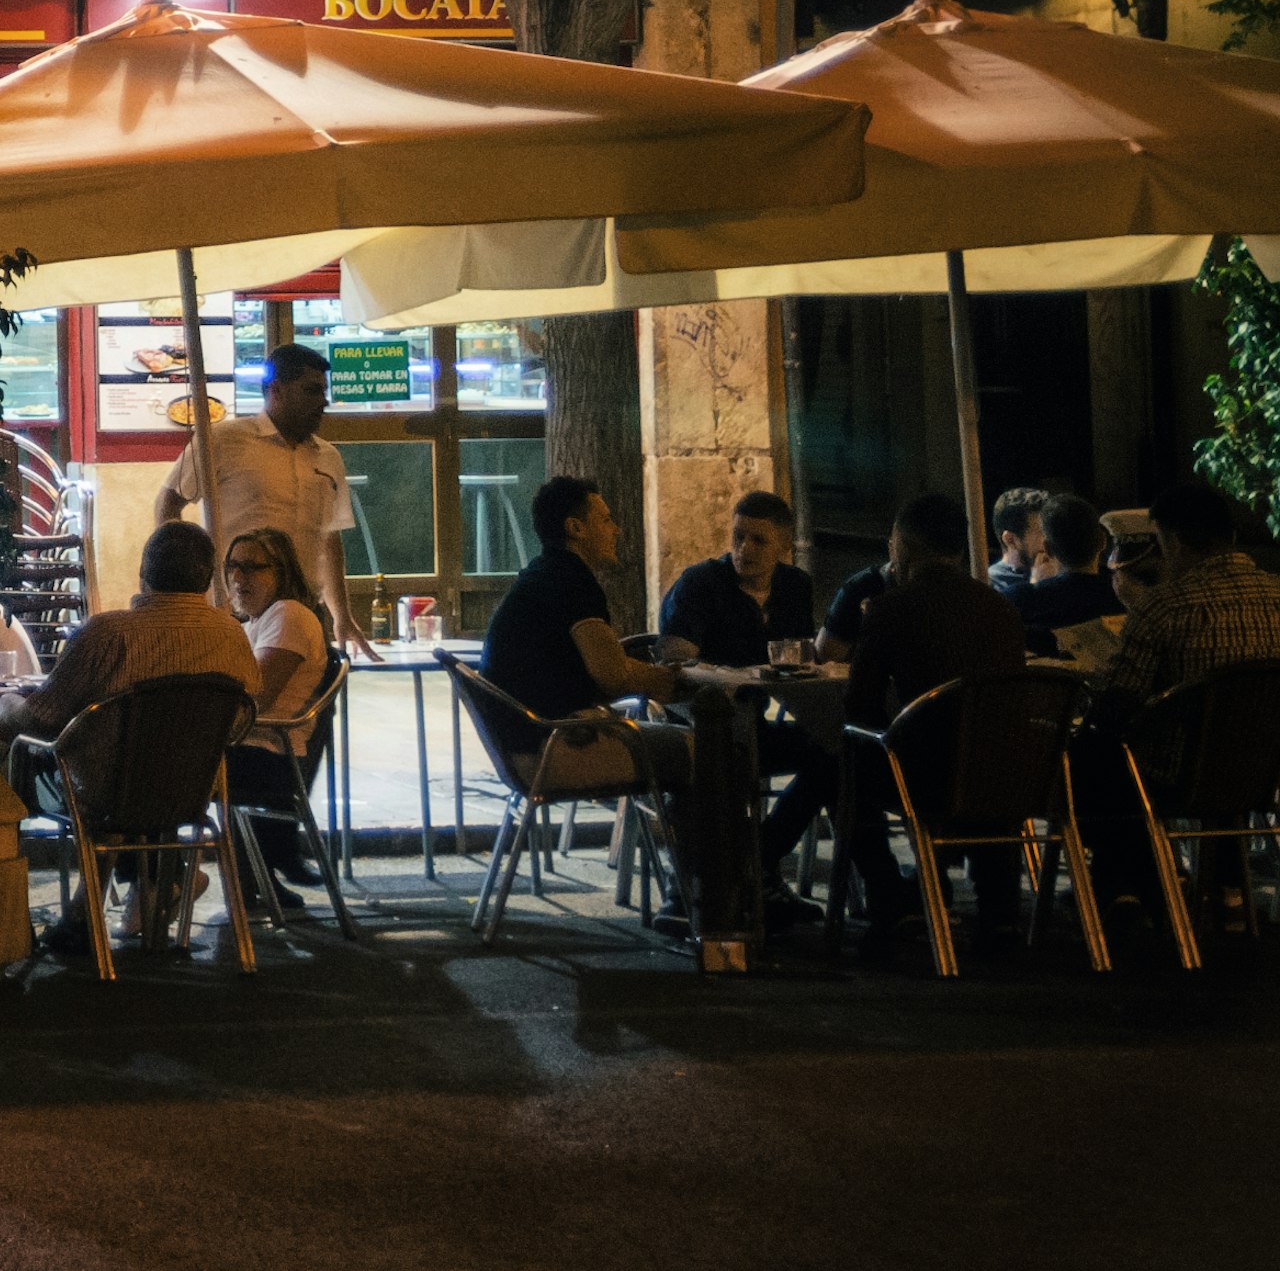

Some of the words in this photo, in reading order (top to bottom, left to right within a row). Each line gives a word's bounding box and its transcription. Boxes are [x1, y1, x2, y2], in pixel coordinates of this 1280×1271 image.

[334, 347, 362, 359] PARA
[365, 345, 405, 358] LLEVAR
[331, 371, 357, 382] PARA
[359, 370, 394, 381] TOMAR
[395, 369, 408, 380] EN
[331, 383, 365, 395] MESAS
[366, 383, 374, 394] Y
[376, 382, 408, 394] BARRA
